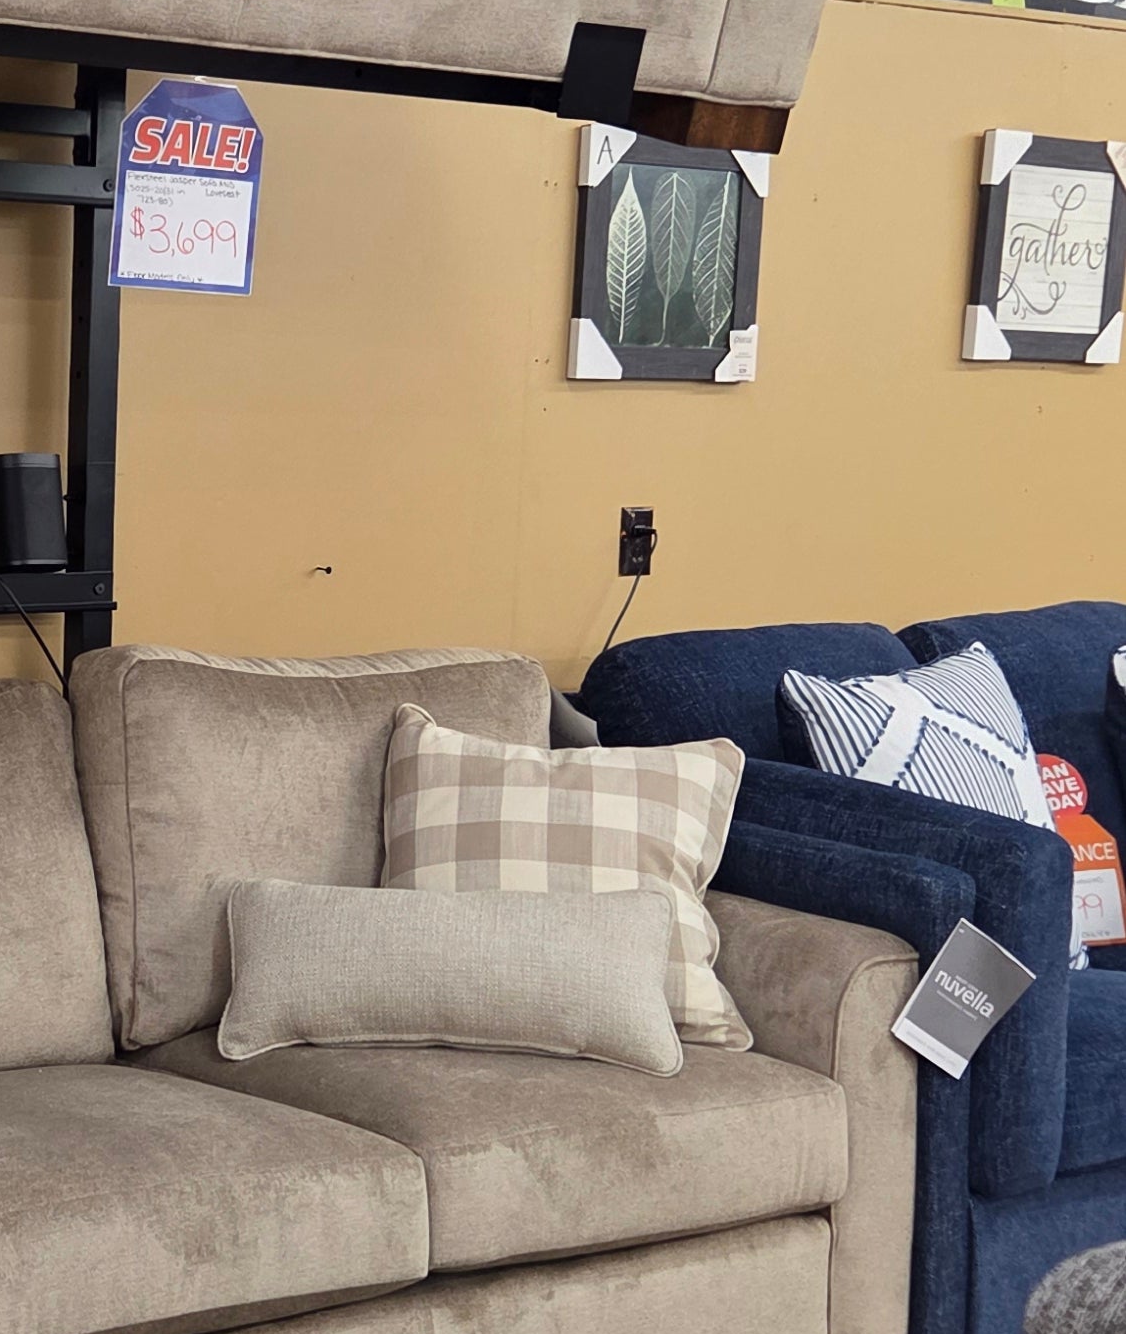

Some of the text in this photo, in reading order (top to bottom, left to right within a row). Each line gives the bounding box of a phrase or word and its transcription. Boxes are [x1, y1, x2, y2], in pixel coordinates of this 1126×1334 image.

[129, 115, 257, 174] SALE!
[597, 135, 614, 165] A
[130, 206, 237, 258] $3,699
[997, 184, 1107, 309] gather
[1042, 763, 1069, 780] AN
[1044, 776, 1080, 797] AVE
[1048, 791, 1084, 812] DAY
[934, 970, 995, 1018] nuvella
